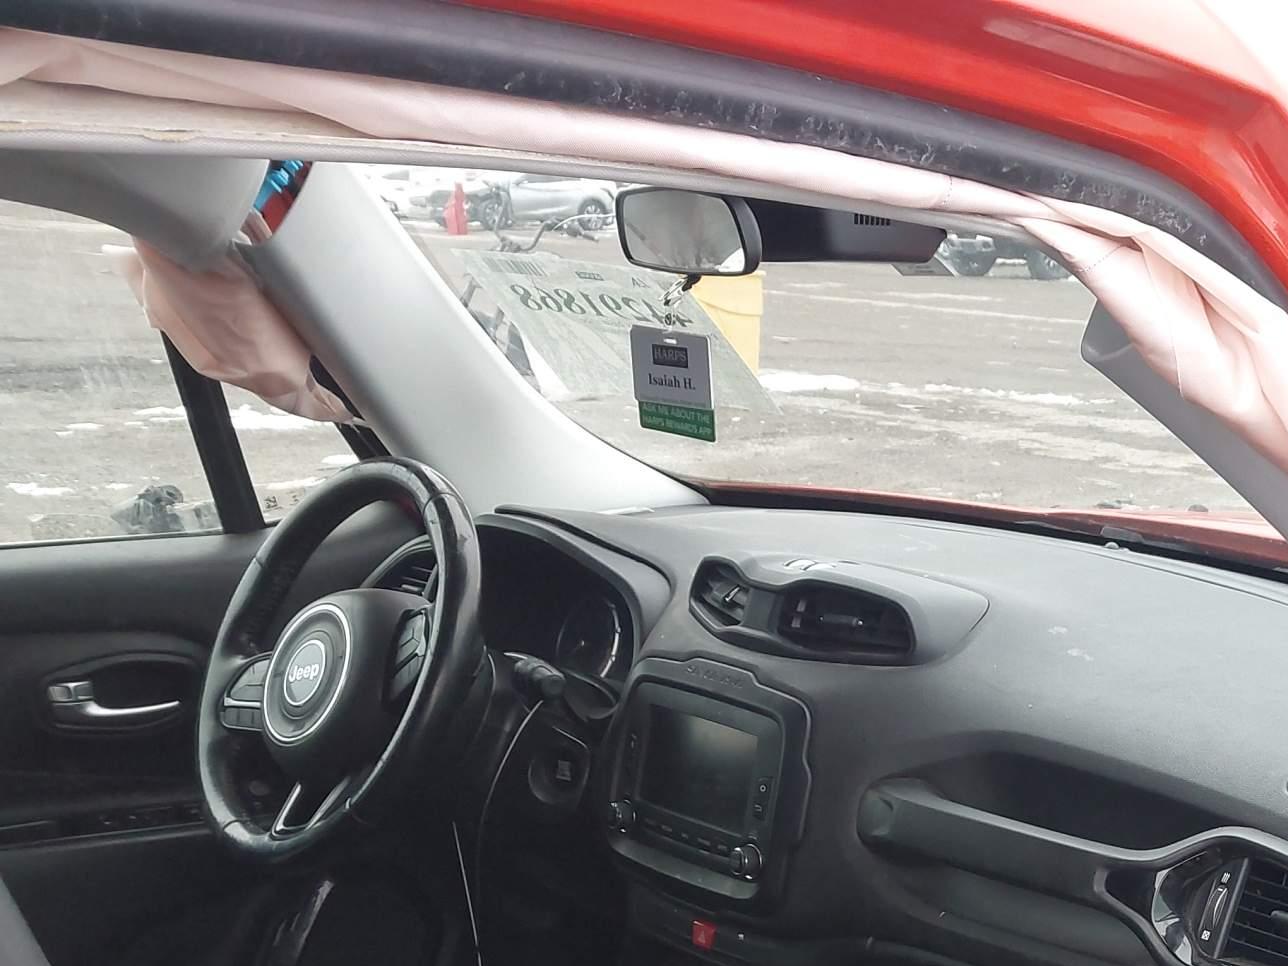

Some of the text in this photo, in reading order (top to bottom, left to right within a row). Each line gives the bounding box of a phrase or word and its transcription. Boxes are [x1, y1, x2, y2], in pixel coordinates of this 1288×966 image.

[648, 373, 696, 390] Isaiah H.
[643, 403, 657, 413] ASK
[671, 407, 696, 420] ABOUT
[697, 412, 710, 424] THE
[699, 426, 713, 436] APP
[289, 664, 319, 682] Jeep
